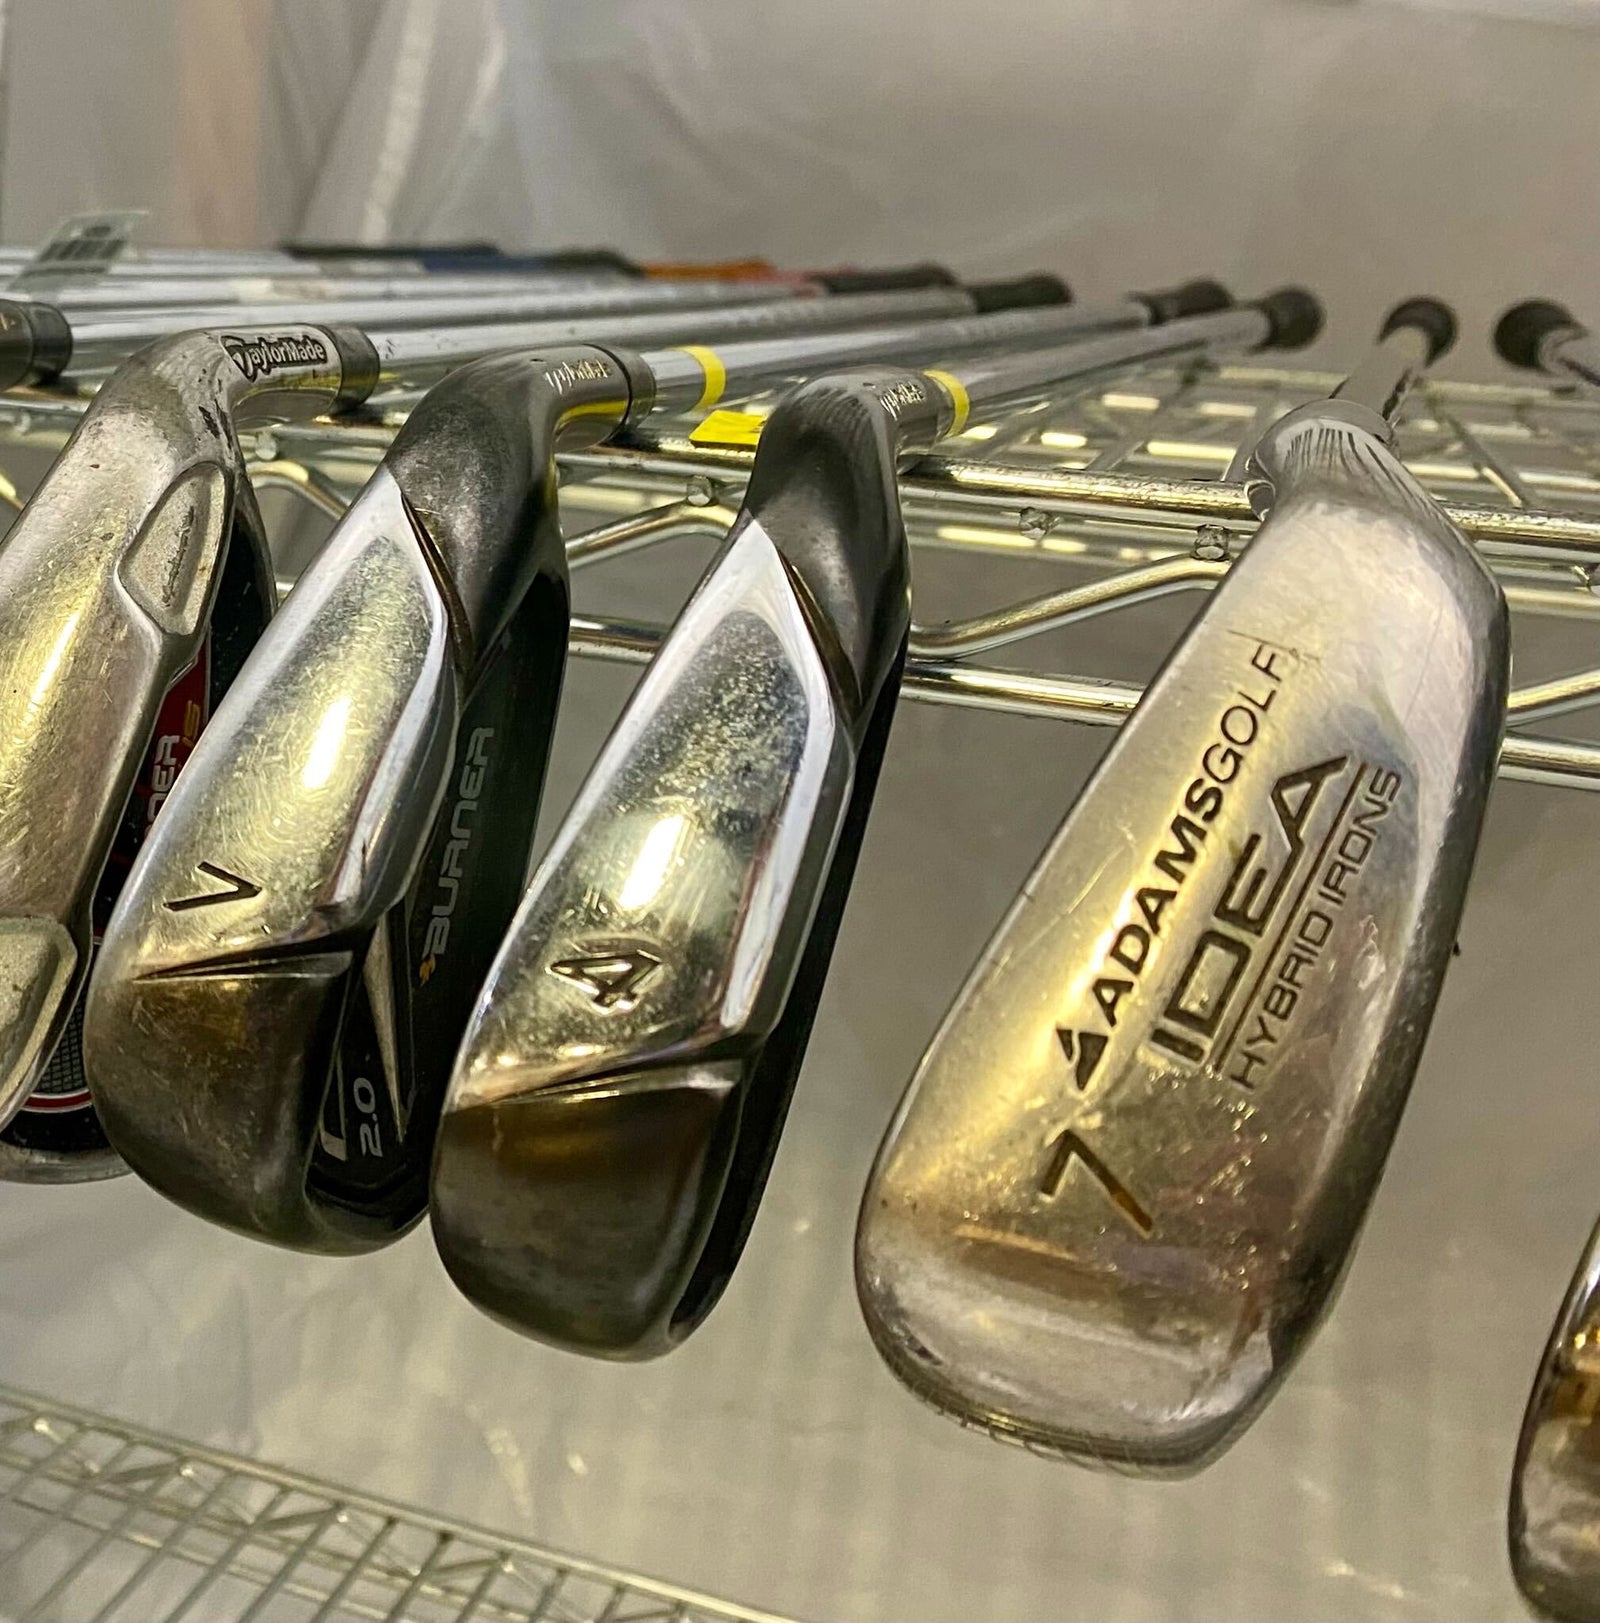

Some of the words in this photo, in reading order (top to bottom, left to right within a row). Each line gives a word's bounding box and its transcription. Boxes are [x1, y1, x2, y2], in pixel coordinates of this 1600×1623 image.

[220, 335, 328, 382] TaylorMade
[422, 727, 494, 955] BURNER
[1091, 644, 1282, 1027] ADAMSGOLF
[1152, 755, 1347, 1063] IDEA
[549, 953, 660, 1008] 4
[1229, 910, 1333, 1089] HYBRID
[1318, 767, 1401, 906] IRONS
[353, 1077, 383, 1157] 2.0
[1040, 1128, 1153, 1234] 7
